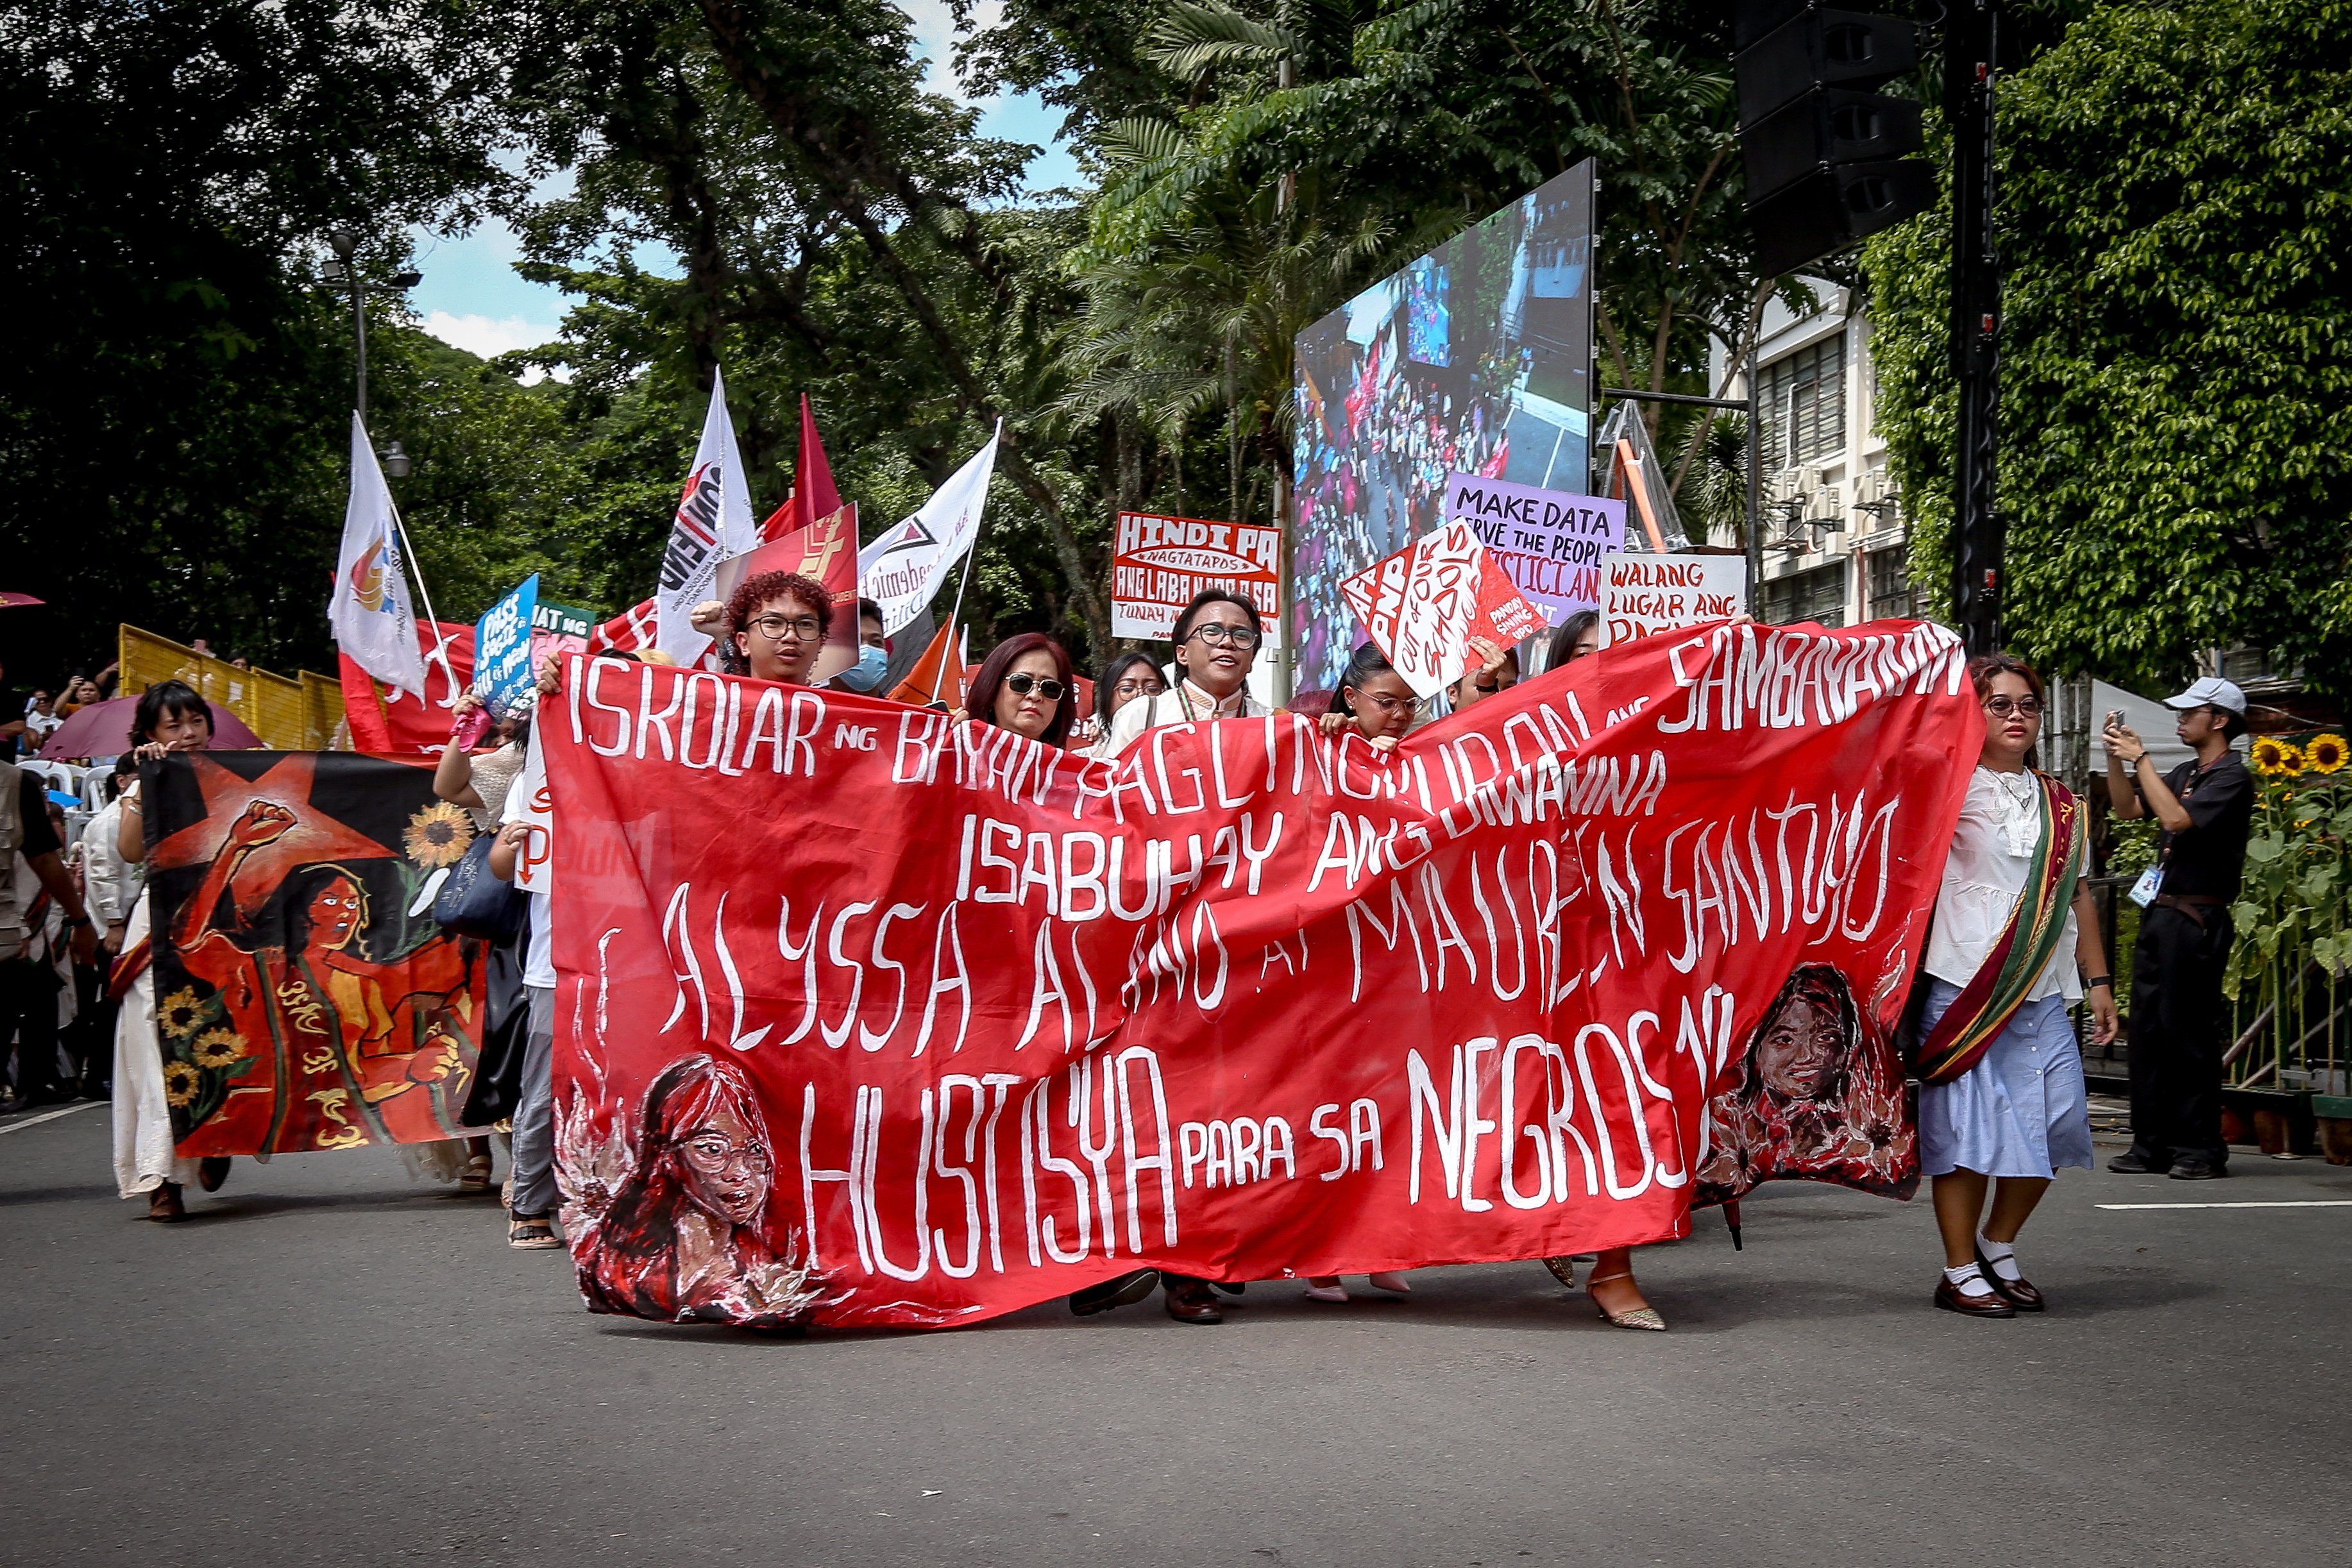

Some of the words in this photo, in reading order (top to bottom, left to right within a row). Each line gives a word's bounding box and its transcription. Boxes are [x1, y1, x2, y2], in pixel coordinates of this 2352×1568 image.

[1453, 516, 1508, 546] ERVE
[1514, 530, 1546, 552] THE
[1457, 487, 1539, 525] MAKE
[1543, 502, 1610, 537] DATA
[1117, 515, 1232, 557] HINDI
[1236, 528, 1279, 575] PA
[1147, 550, 1239, 571] NAGTATAPOS
[1413, 537, 1443, 601] OUR
[1116, 566, 1145, 598] ANG
[1252, 581, 1277, 614] SA
[1342, 568, 1377, 625] AFP
[1611, 562, 1704, 588] WALANG
[483, 593, 520, 641] PASS
[1117, 603, 1165, 623] TUNAY
[1370, 555, 1405, 660] PNP
[1409, 595, 1421, 623] OF
[1425, 524, 1477, 687] SCHOOLS
[1489, 597, 1525, 625] PANDAY
[1495, 607, 1533, 636] SINING
[1609, 591, 1685, 619] LUGAR
[1693, 593, 1736, 617] ANG
[1402, 620, 1420, 673] OUT
[1511, 625, 1534, 640] UPD
[569, 654, 827, 778] ISKOLAR
[834, 723, 879, 751] NG
[892, 710, 1064, 807] BAYAN
[956, 811, 1284, 922] ISABUHAY
[1307, 810, 1432, 893] ANG
[1562, 748, 1666, 817] NINA
[659, 881, 972, 1058] ALYSSA
[1663, 787, 1901, 974] SANTUYO
[799, 1045, 1178, 1281] HUSTISYA
[1179, 1115, 1296, 1190] PARA
[1309, 1097, 1384, 1181] SA
[1407, 1009, 1688, 1213] NEGROS
